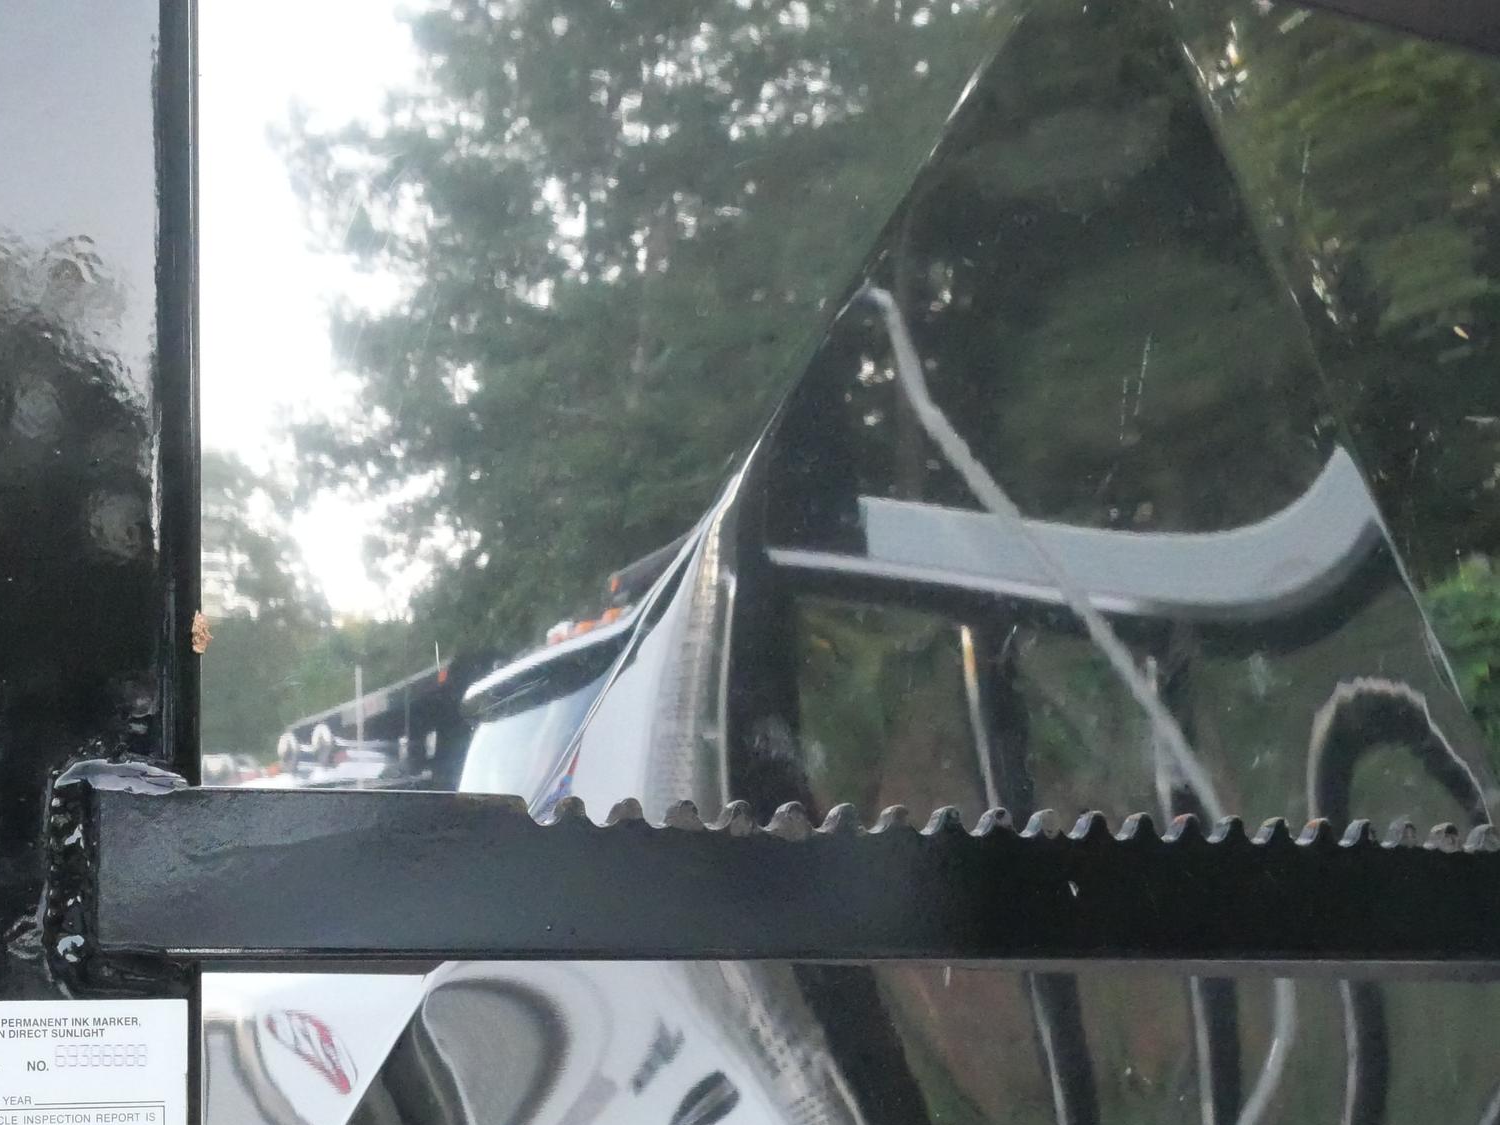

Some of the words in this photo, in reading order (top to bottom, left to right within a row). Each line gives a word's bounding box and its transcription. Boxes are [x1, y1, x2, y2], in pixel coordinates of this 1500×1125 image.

[1, 1017, 68, 1028] PERMANENT
[71, 1017, 90, 1027] INK
[92, 1017, 141, 1026] MARKER,
[8, 1029, 48, 1039] DIRECT
[51, 1028, 105, 1038] SUNLIGHT
[27, 1060, 49, 1072] NO.
[2, 1096, 32, 1106] YEAR
[23, 1114, 91, 1125] INSPECTION
[96, 1112, 141, 1123] REPORT
[146, 1112, 156, 1122] IS
